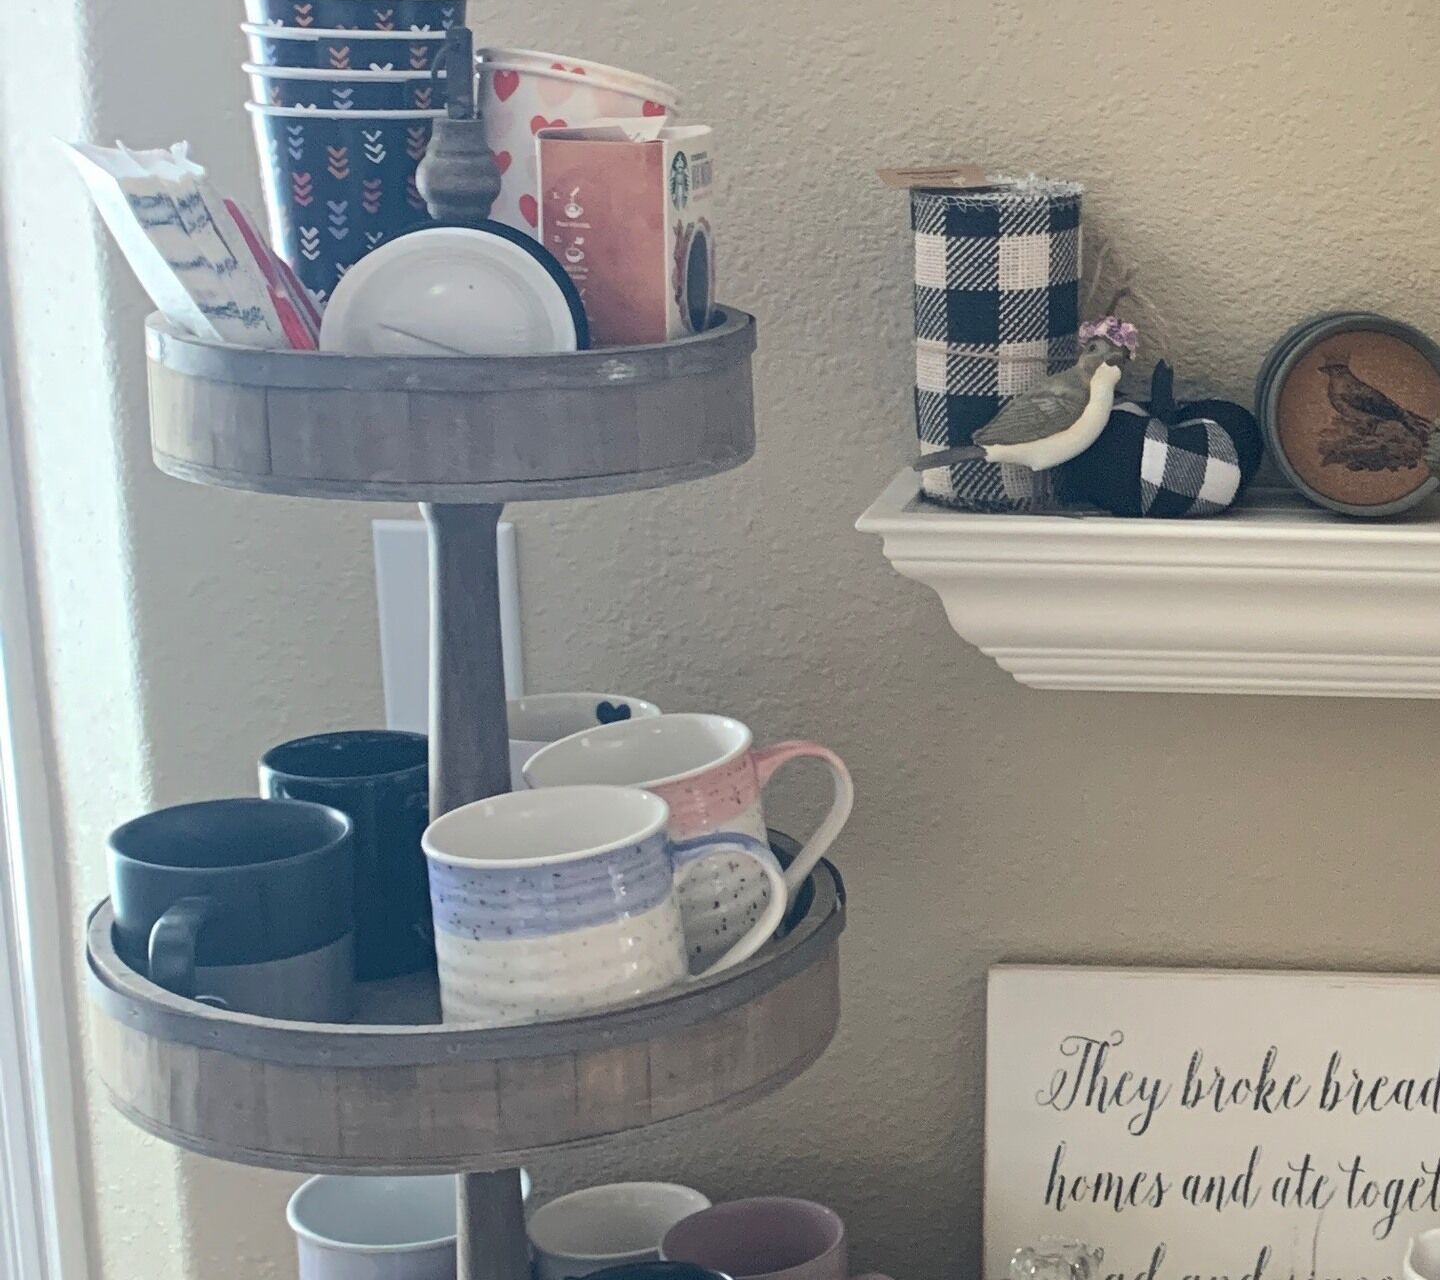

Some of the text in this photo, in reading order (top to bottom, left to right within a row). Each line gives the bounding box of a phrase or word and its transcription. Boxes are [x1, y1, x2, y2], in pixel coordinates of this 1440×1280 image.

[1035, 1029, 1172, 1137] They
[1180, 1046, 1312, 1114] broke
[1044, 1140, 1173, 1212] homes
[1182, 1145, 1262, 1212] and
[1271, 1153, 1338, 1210] ate
